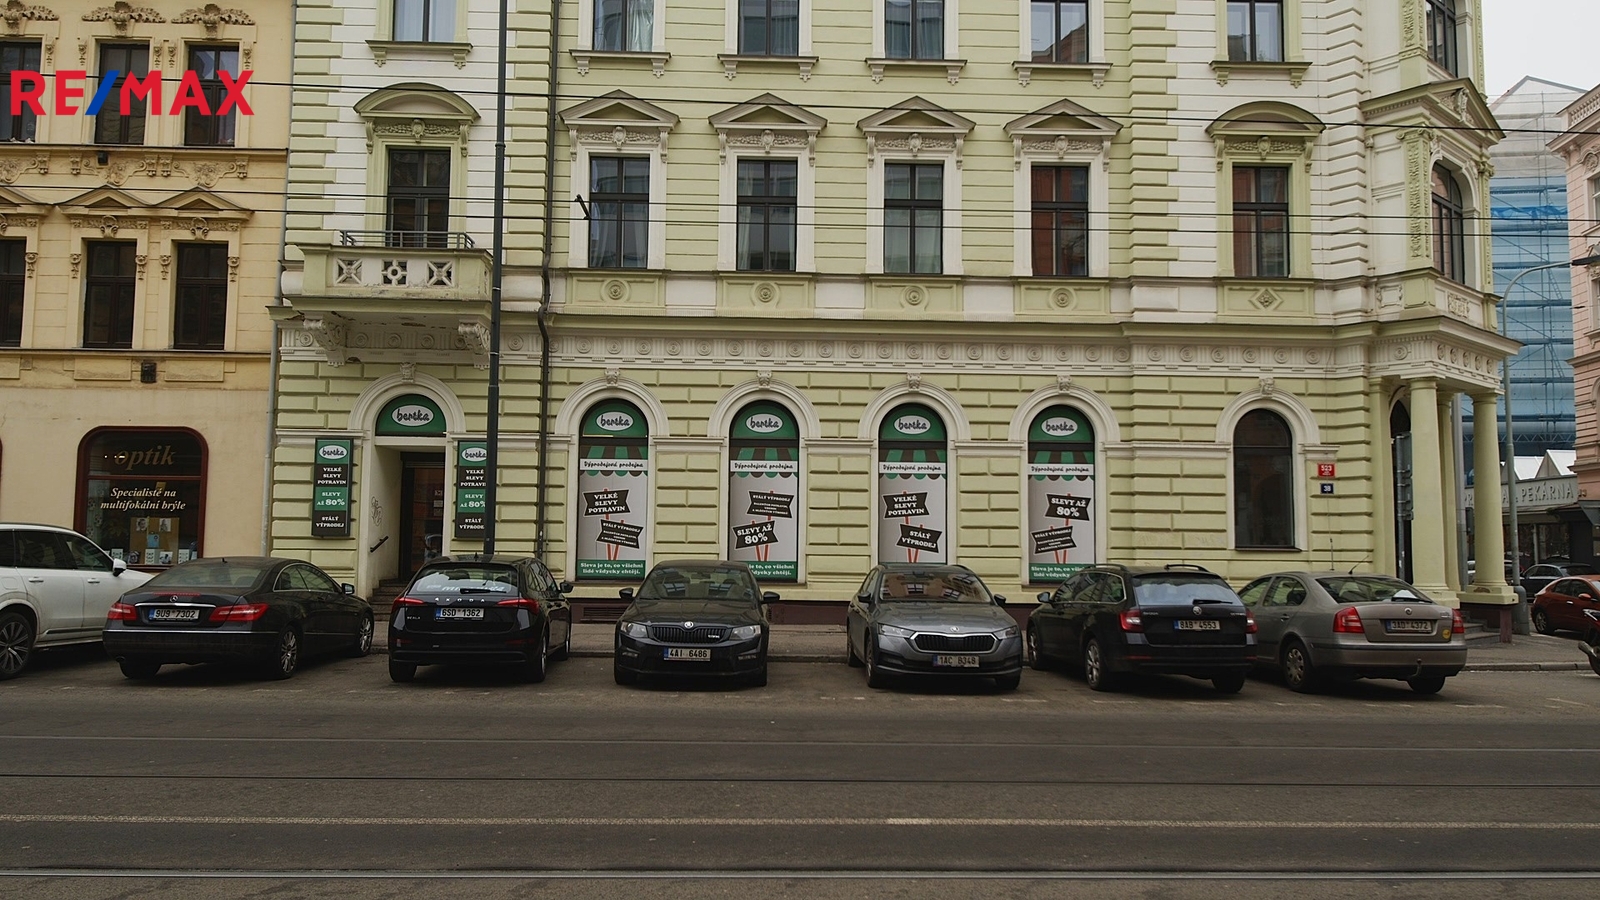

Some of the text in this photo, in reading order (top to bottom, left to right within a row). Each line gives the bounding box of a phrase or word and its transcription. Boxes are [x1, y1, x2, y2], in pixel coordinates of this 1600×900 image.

[114, 445, 176, 471] optik
[111, 487, 163, 499] Specialisté
[593, 492, 619, 500] VELKÉ
[1521, 482, 1574, 502] PEKÁRNA
[100, 500, 187, 512] multifokální brýle
[325, 498, 345, 506] 80%
[594, 499, 618, 507] SLEVY
[1051, 497, 1086, 507] SLEVY AŽ
[588, 505, 626, 513] POTRAVIN
[888, 508, 925, 516] POTRAVIN
[1056, 506, 1080, 517] 80%
[737, 523, 773, 536] SLEVY AŽ
[744, 532, 768, 544] 80%
[909, 530, 931, 539] STÁLÝ
[901, 537, 936, 549] VÝPRODEJ
[155, 610, 196, 618] 9U9 7302
[1180, 621, 1217, 629] 8AB 4553
[1410, 621, 1428, 629] 4372
[669, 649, 683, 657] 4AI
[940, 656, 953, 664] 1AC
